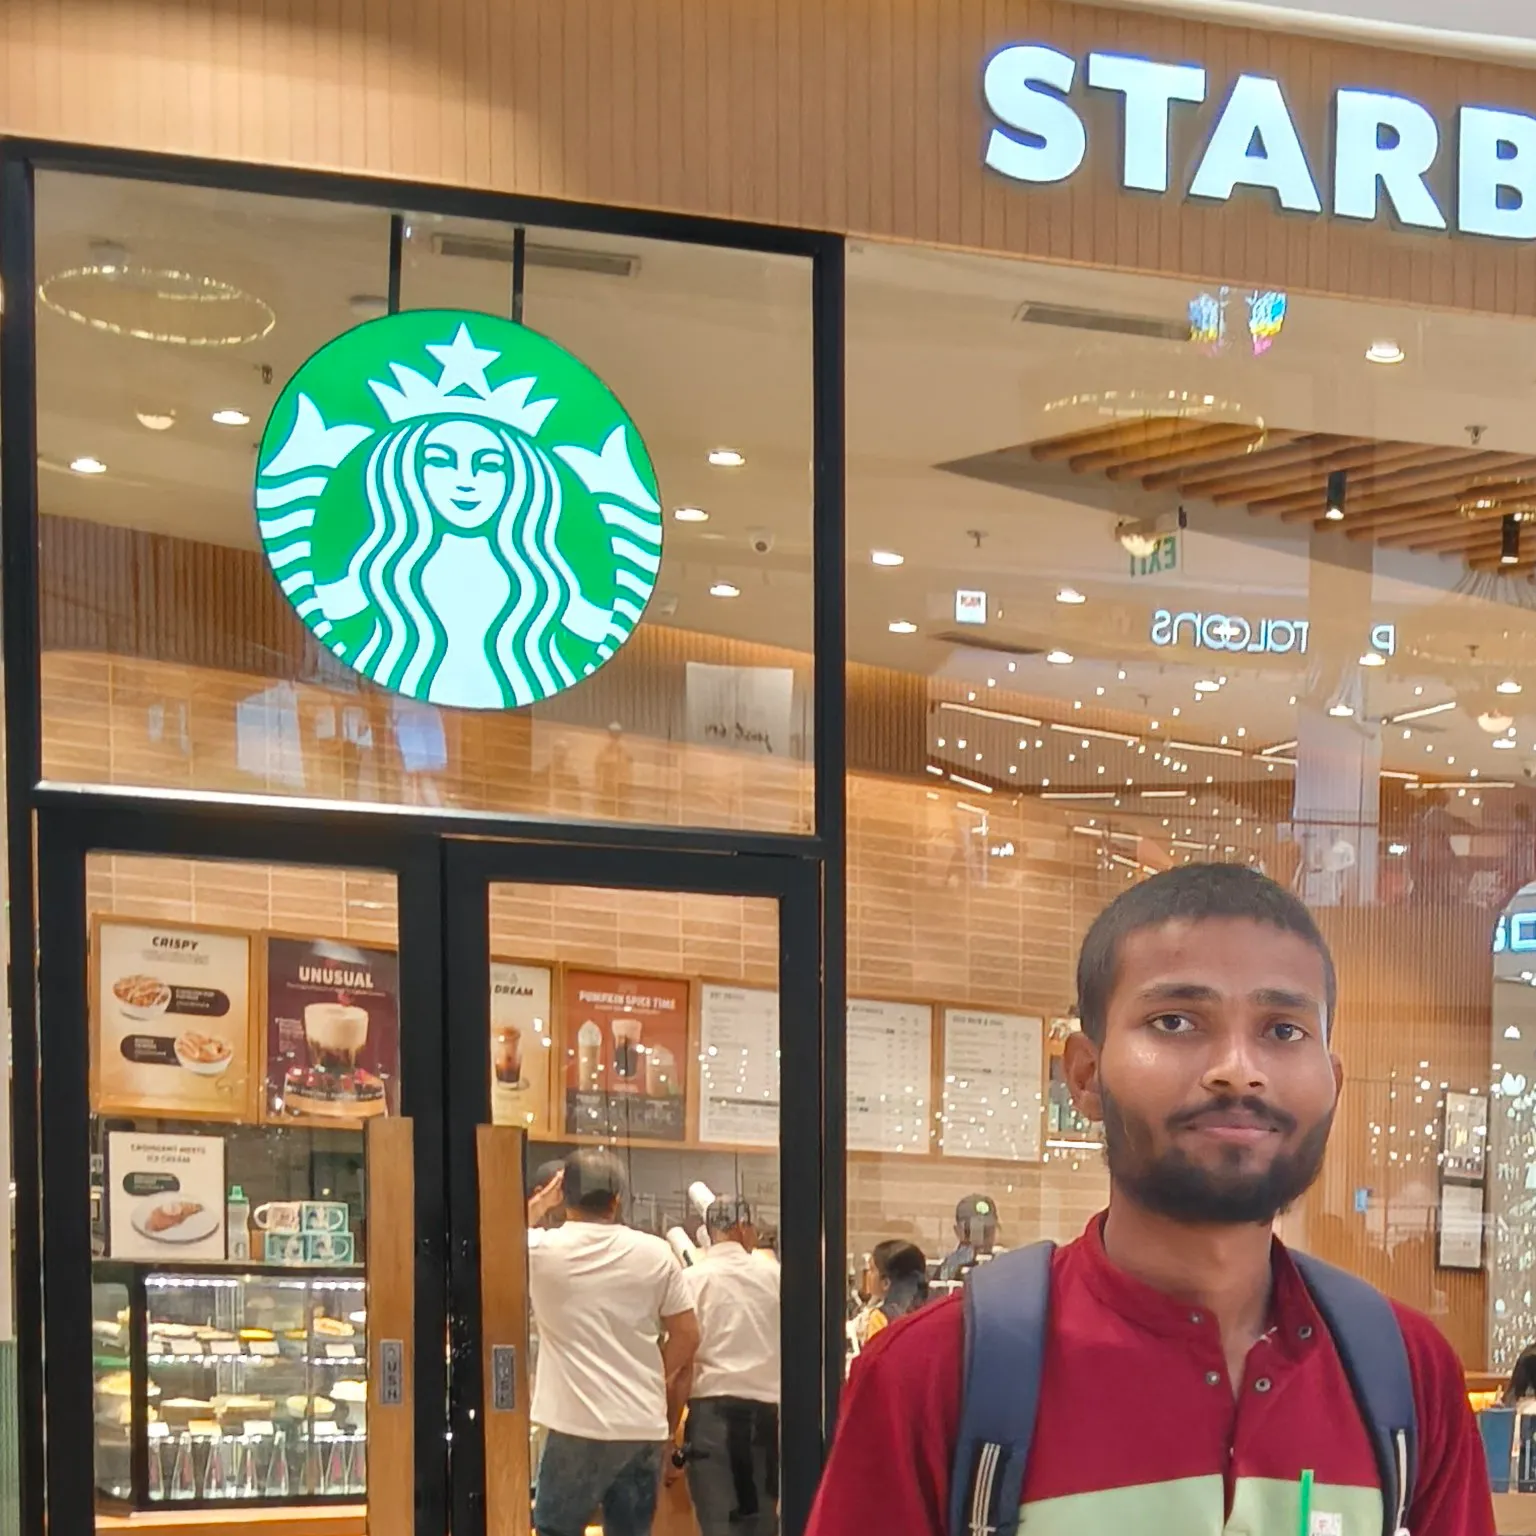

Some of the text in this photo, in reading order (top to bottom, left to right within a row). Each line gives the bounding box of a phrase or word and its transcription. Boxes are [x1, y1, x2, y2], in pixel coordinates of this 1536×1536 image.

[152, 936, 199, 951] CRISPY
[299, 966, 374, 989] UNUSUAL
[494, 983, 533, 997] DREAM
